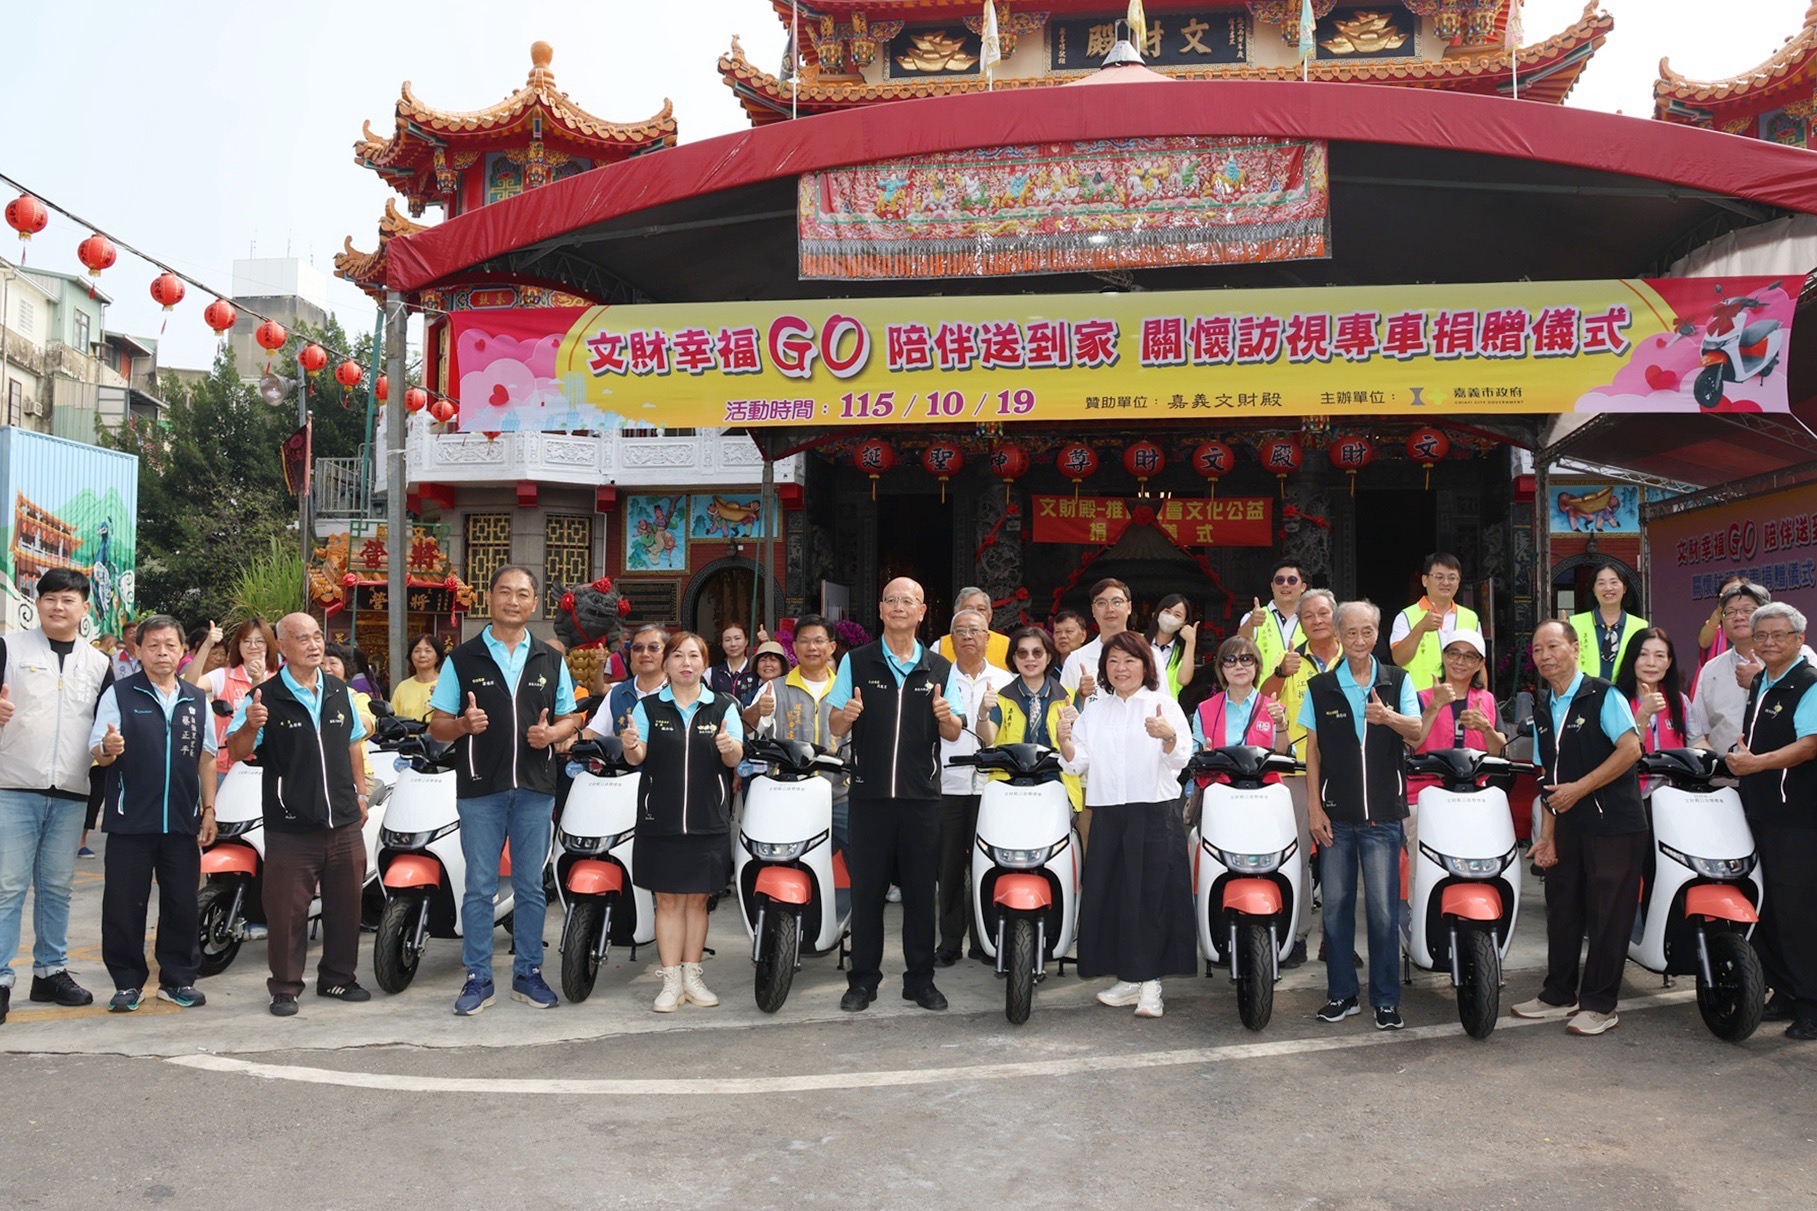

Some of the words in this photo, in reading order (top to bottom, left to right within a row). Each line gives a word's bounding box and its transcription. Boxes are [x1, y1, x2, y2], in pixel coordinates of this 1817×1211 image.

[887, 320, 1116, 367] 陪伴送到家
[1141, 306, 1628, 361] 關懷訪視專車捐贈儀式
[838, 391, 895, 418] 115
[926, 390, 964, 416] 10
[997, 389, 1036, 414] 19
[1167, 392, 1283, 410] 嘉義文財殿
[1453, 386, 1523, 399] 嘉義市政府
[862, 446, 886, 469] 誕
[928, 447, 954, 471] 聖
[1269, 444, 1295, 467] 殿
[1340, 442, 1367, 465] 財
[1413, 435, 1439, 459] 文
[1065, 449, 1091, 473] 尊
[1134, 448, 1159, 472] 財
[1201, 447, 1225, 472] 文
